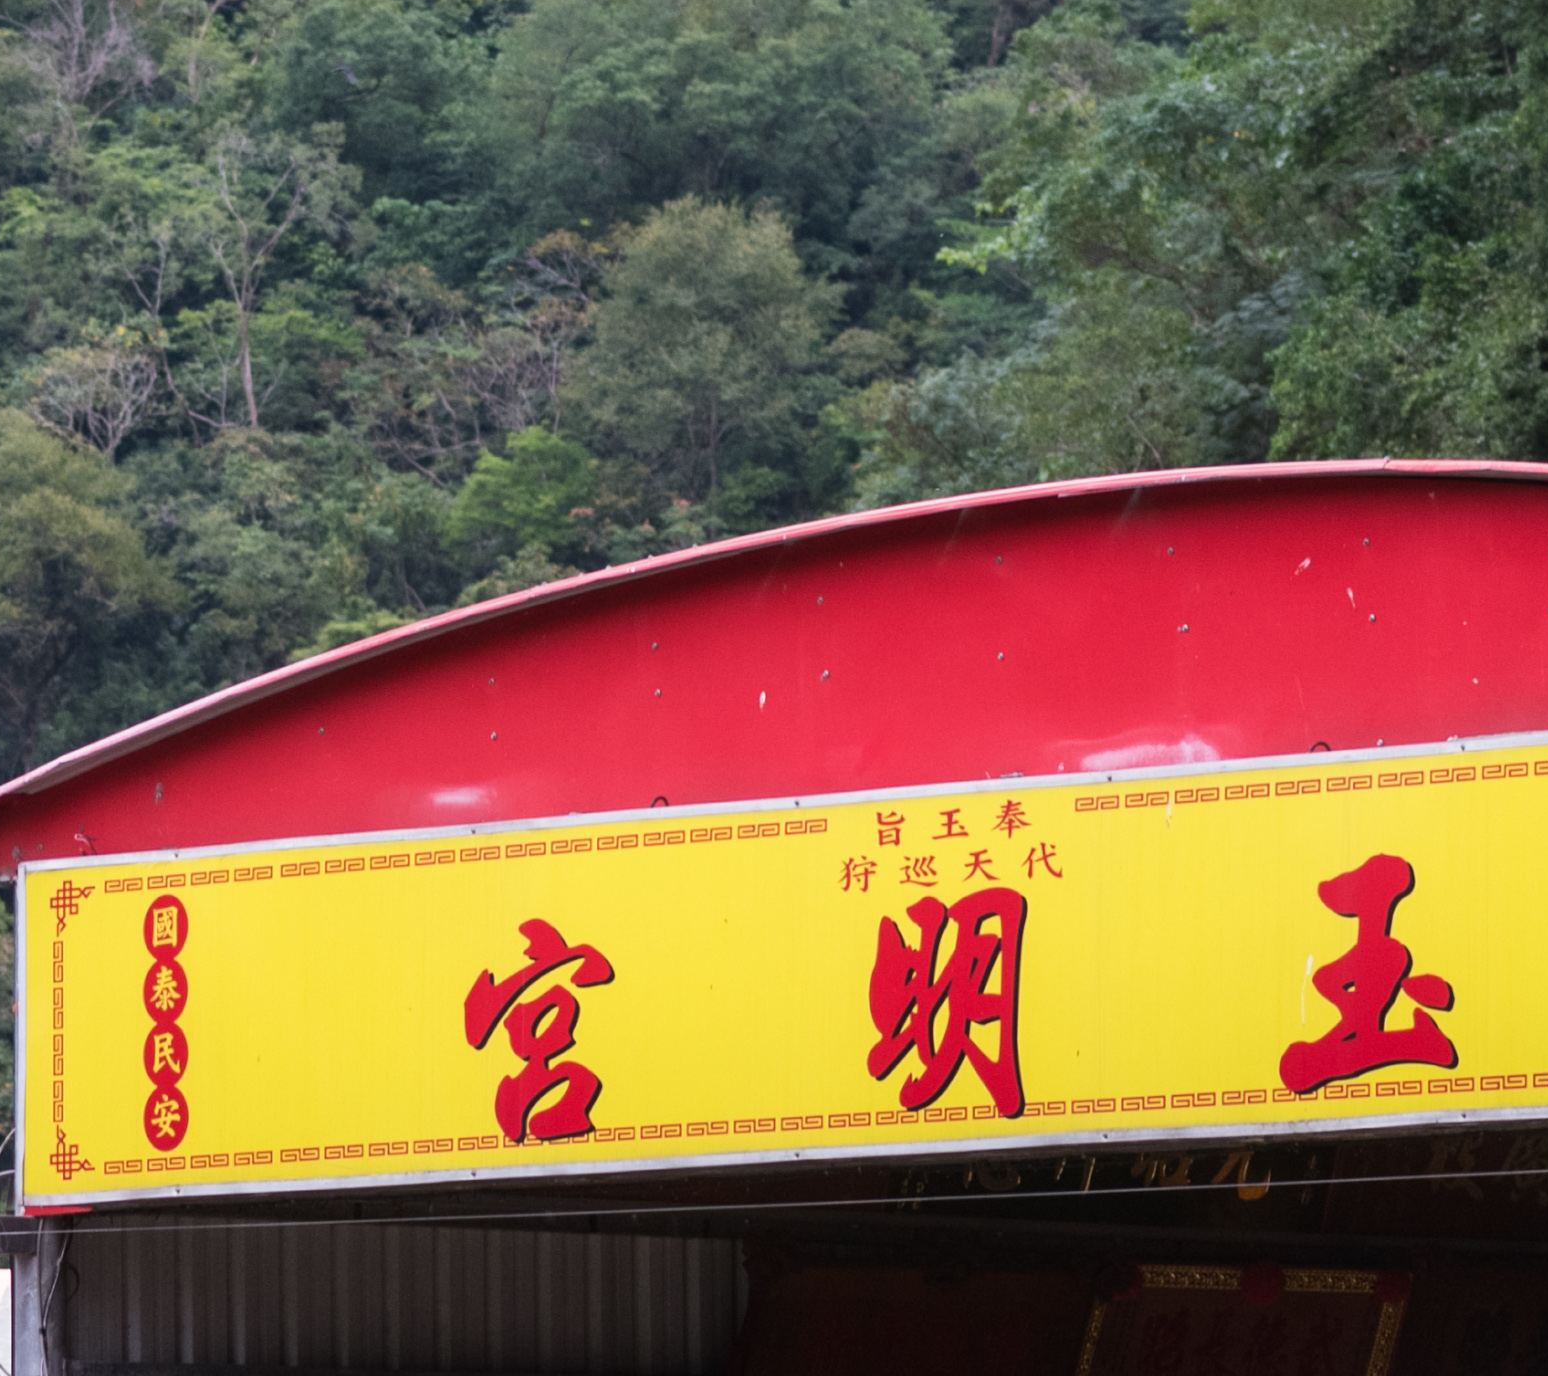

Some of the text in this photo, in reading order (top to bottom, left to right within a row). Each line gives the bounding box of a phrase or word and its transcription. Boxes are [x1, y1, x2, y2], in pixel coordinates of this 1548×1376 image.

[875, 799, 1032, 847] 奉玉旨
[837, 841, 1064, 893] 代天巡狩
[150, 905, 182, 1138] 國泰民安
